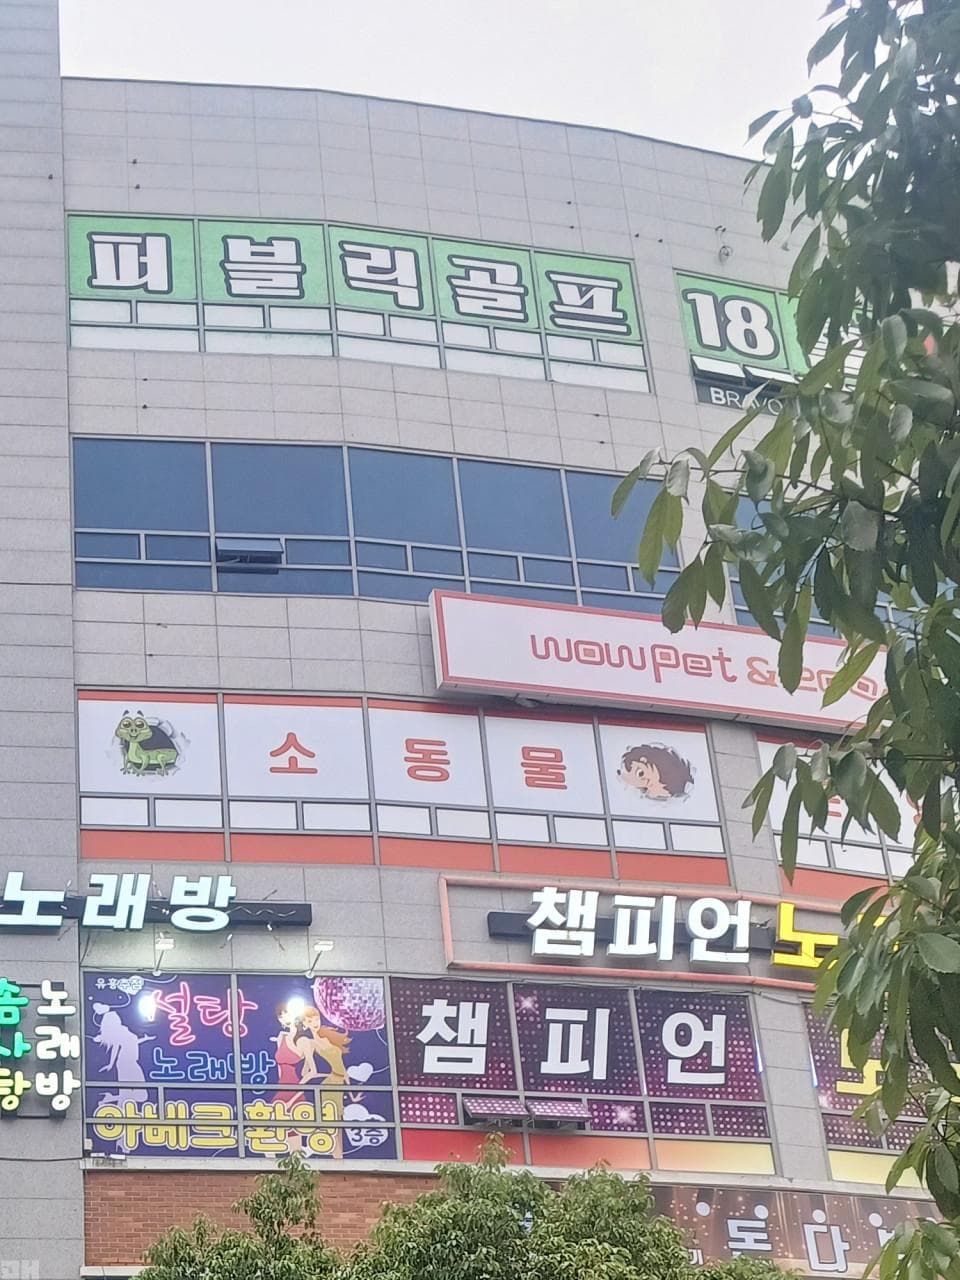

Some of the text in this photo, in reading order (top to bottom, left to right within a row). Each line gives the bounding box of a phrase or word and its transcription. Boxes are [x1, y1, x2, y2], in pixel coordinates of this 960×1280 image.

[682, 288, 780, 360] 18
[526, 886, 752, 964] 챔피언
[146, 982, 259, 1046] 설탕
[416, 999, 727, 1085] 챔피언
[149, 1047, 277, 1095] 노래방
